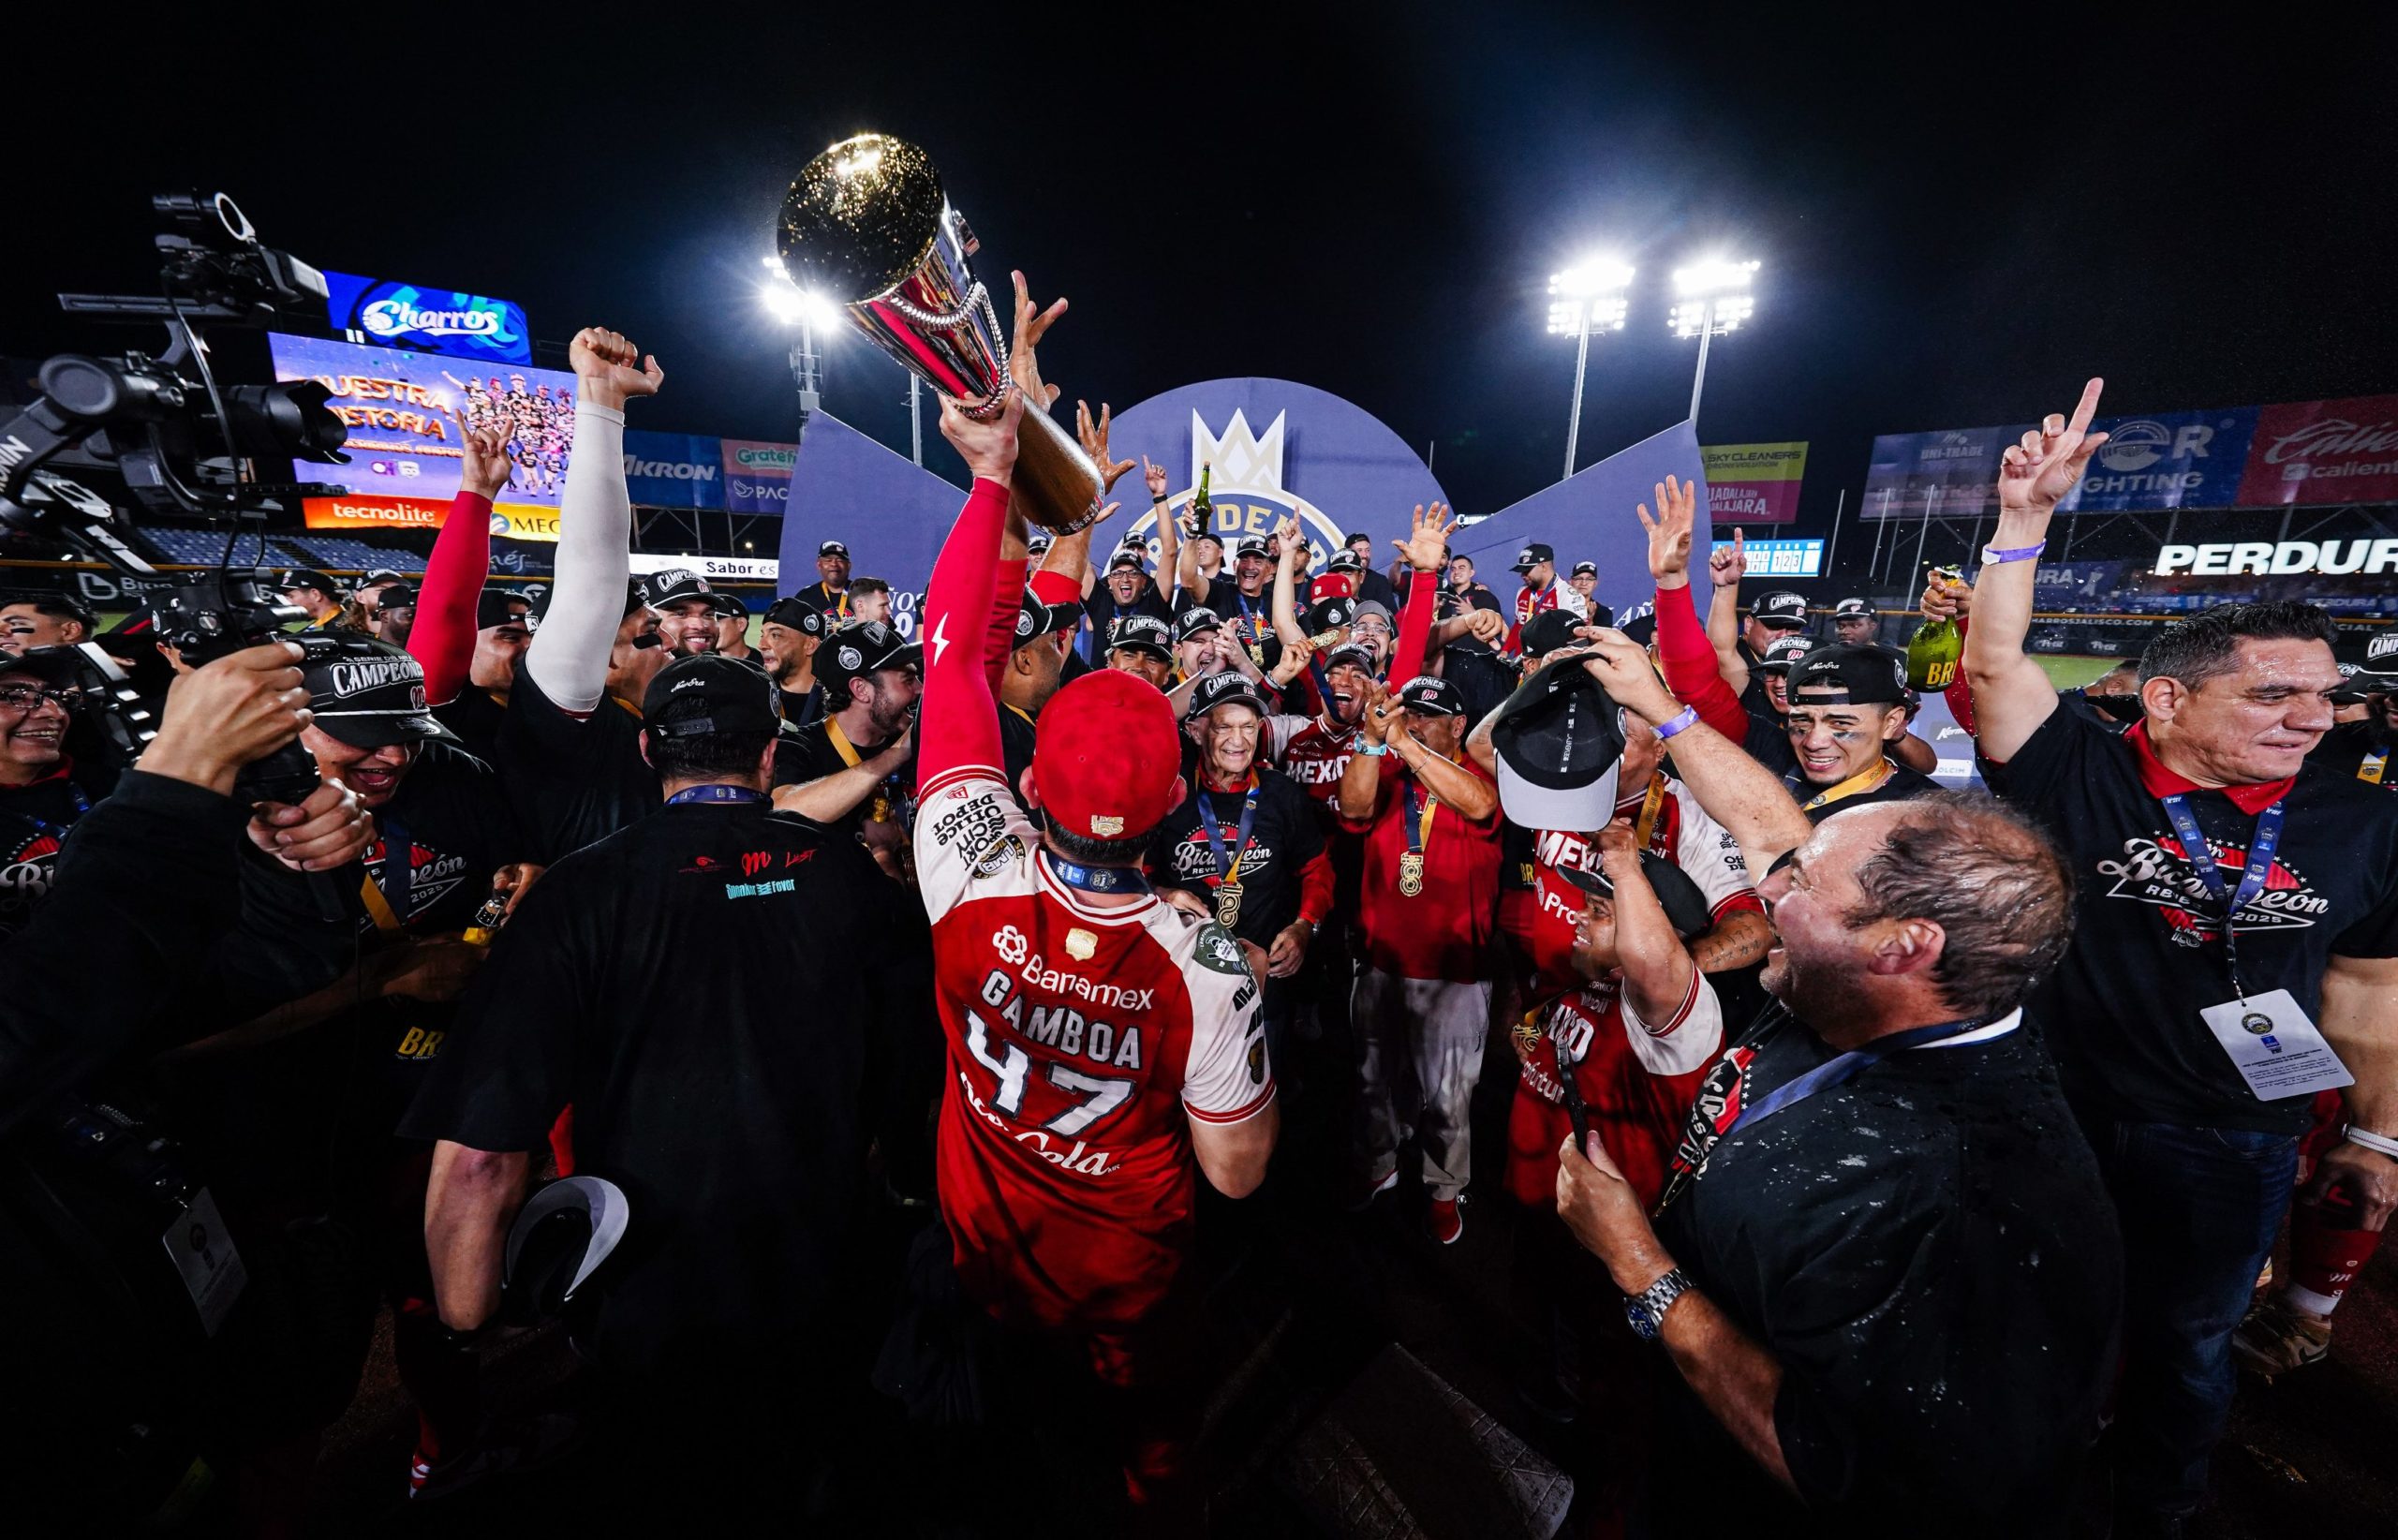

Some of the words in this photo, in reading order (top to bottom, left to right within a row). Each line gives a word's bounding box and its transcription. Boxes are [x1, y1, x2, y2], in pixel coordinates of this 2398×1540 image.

[363, 300, 499, 337] Charros
[1708, 453, 1731, 463] SKY
[1731, 451, 1801, 462] CLEANERS
[332, 502, 437, 523] tecnolite
[706, 561, 753, 574] Sabor
[759, 564, 777, 574] es
[1021, 955, 1155, 1011] Banamex
[981, 969, 1141, 1070] GAMBOA
[966, 1005, 1134, 1136] 47
